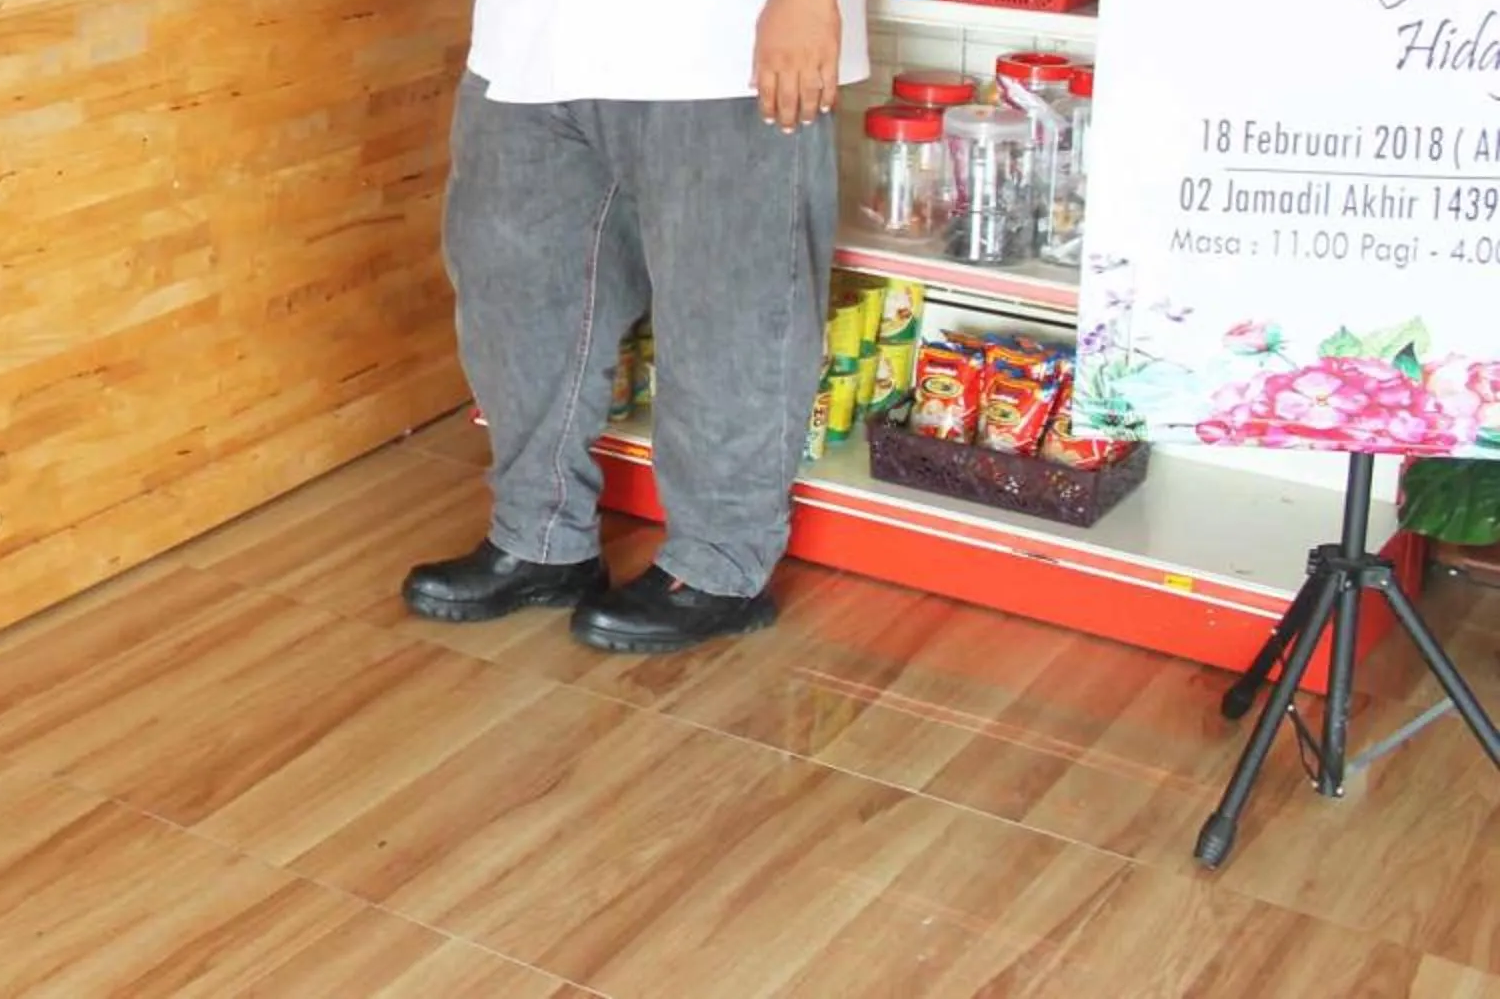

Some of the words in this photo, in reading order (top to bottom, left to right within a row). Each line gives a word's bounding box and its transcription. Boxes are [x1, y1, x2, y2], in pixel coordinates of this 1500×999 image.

[1396, 10, 1500, 101] Hida
[1202, 118, 1232, 153] 18
[1243, 120, 1363, 159] Februari
[1373, 124, 1444, 162] 2018
[1179, 177, 1213, 212] 02
[1222, 179, 1331, 217] Jamadil
[1341, 184, 1419, 220] Akhir
[1434, 185, 1499, 222] 1439
[1169, 227, 1241, 255] Masa
[1273, 229, 1349, 260] 11.00
[1360, 232, 1420, 270] Pagi
[1450, 235, 1500, 265] 4.0
